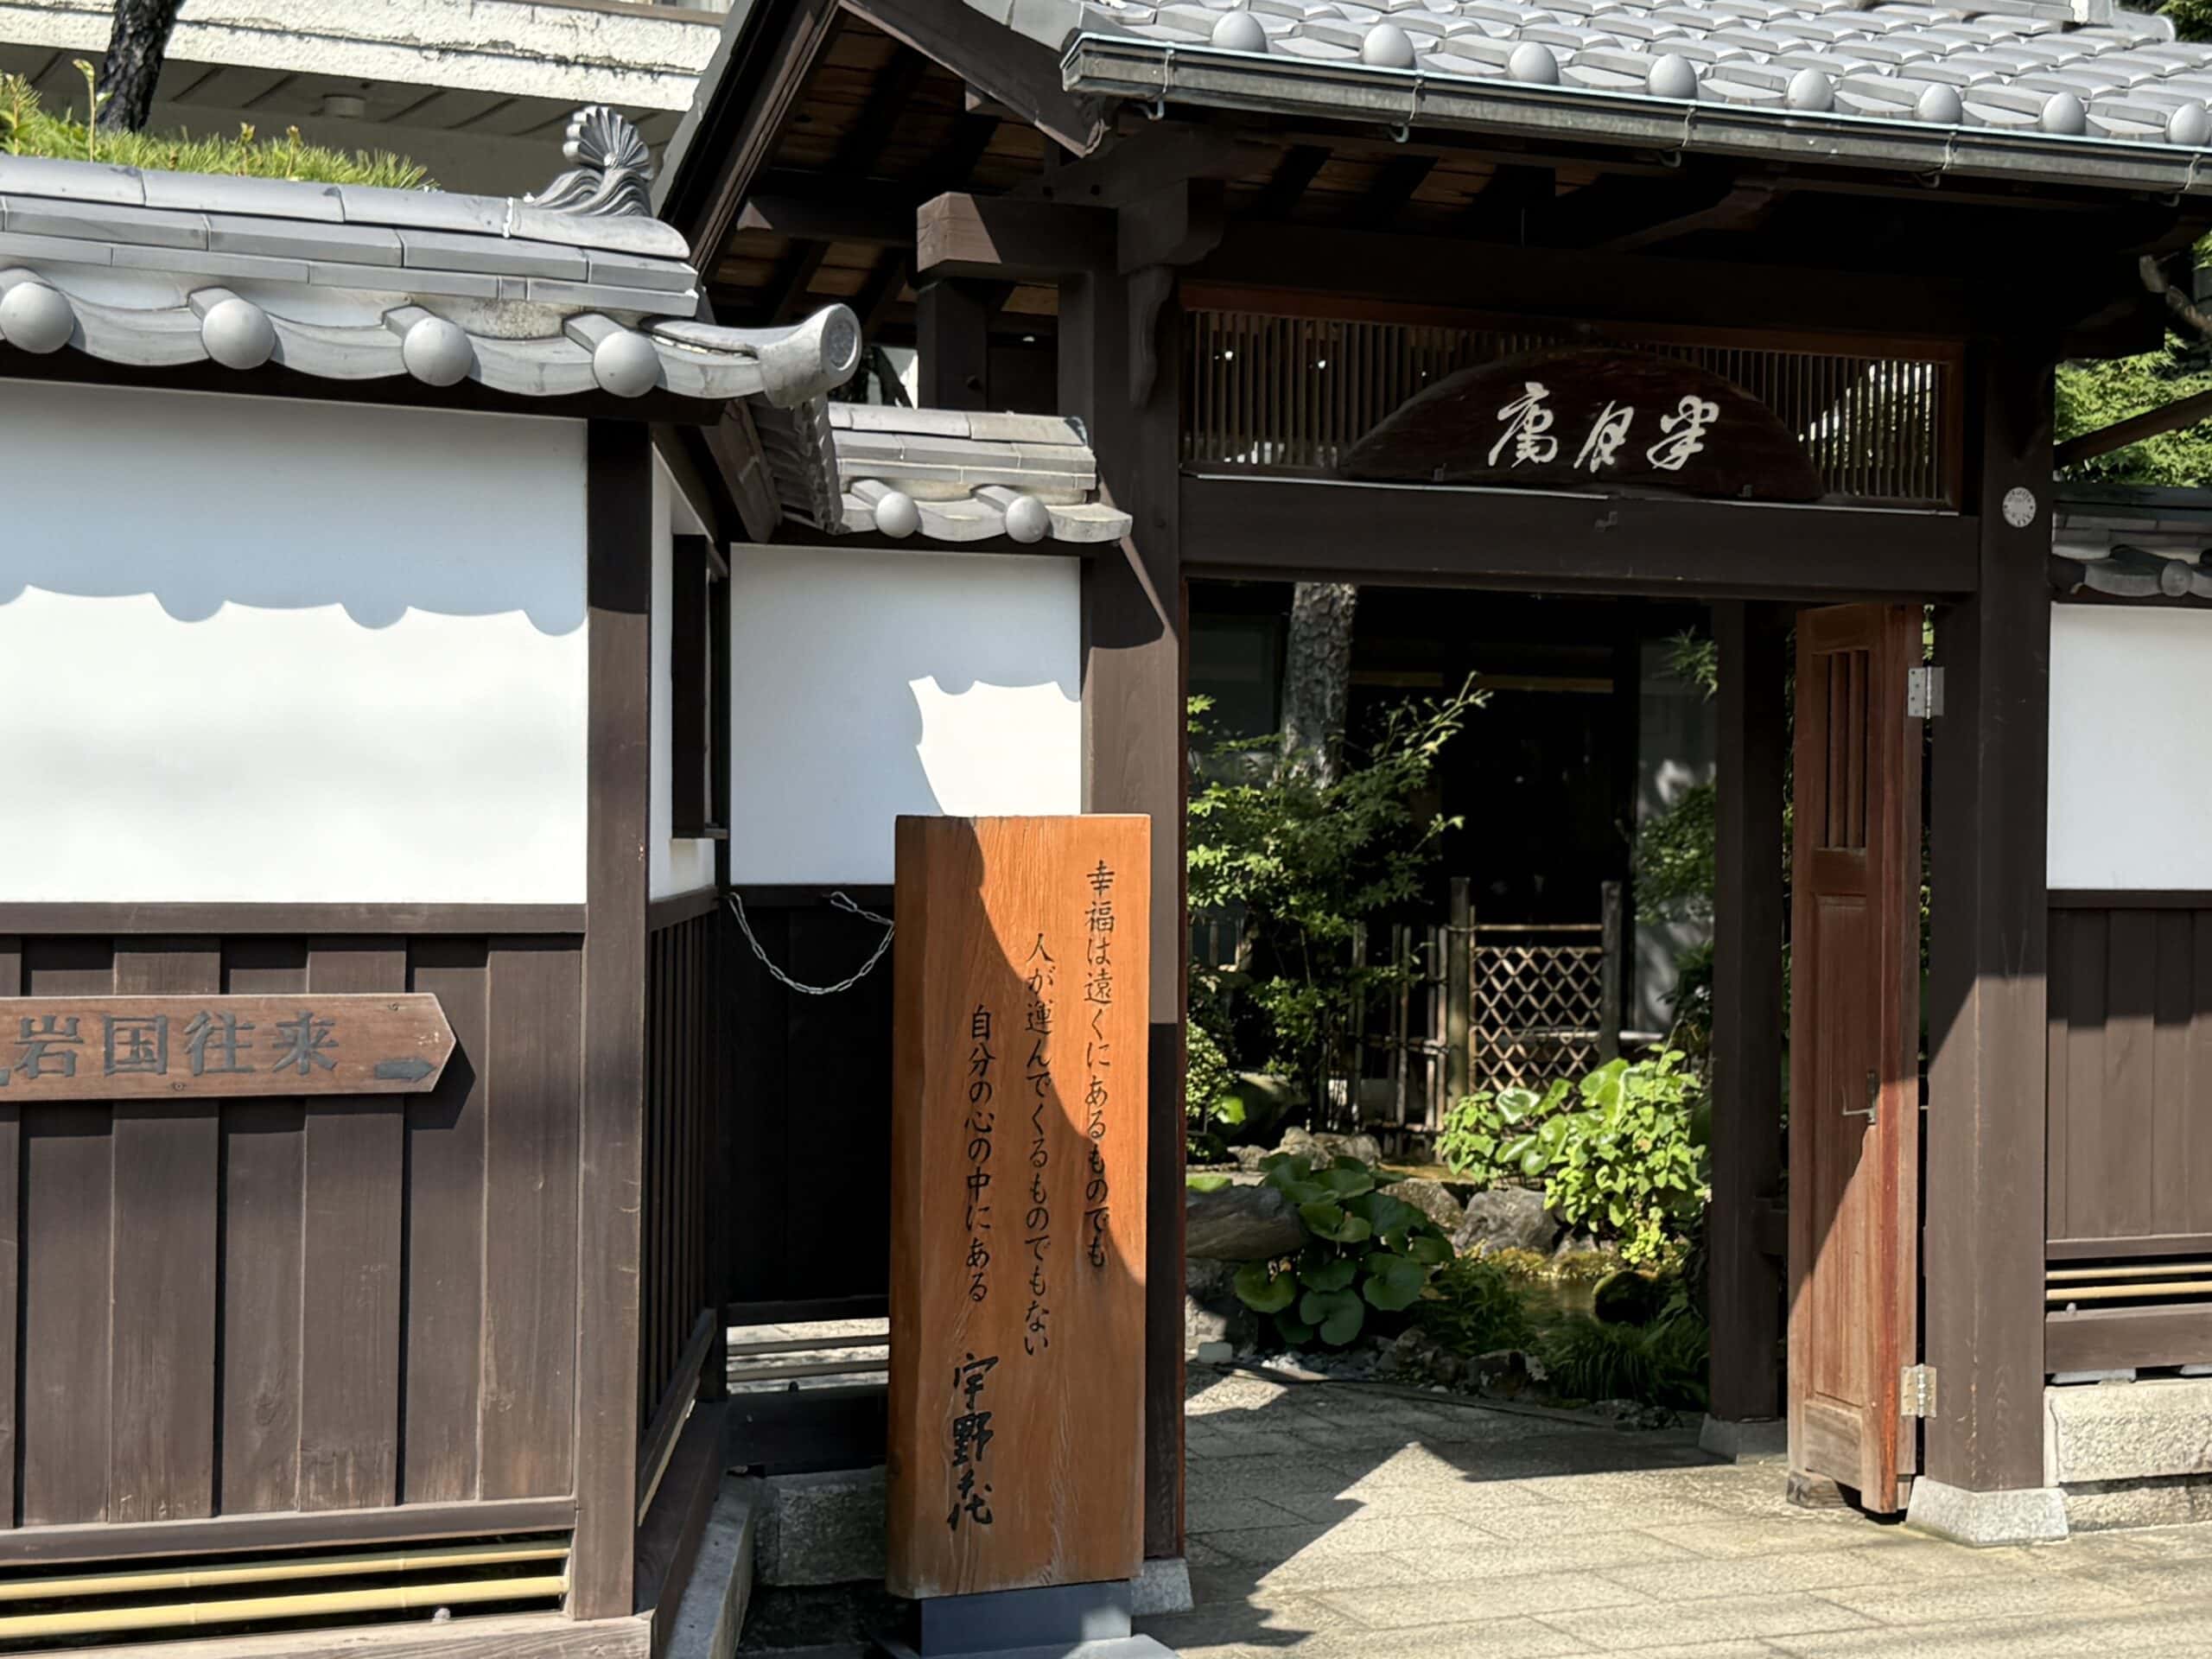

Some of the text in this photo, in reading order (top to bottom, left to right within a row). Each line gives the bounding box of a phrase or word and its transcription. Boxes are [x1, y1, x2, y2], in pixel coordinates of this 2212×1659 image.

[13, 1009, 340, 1080] 岩国往来
[964, 1003, 996, 1302] 自分の心の中にある
[1024, 932, 1057, 1356] 人が運んでくるものでもない
[1084, 860, 1116, 1268] 幸福は遠くにあるものでも
